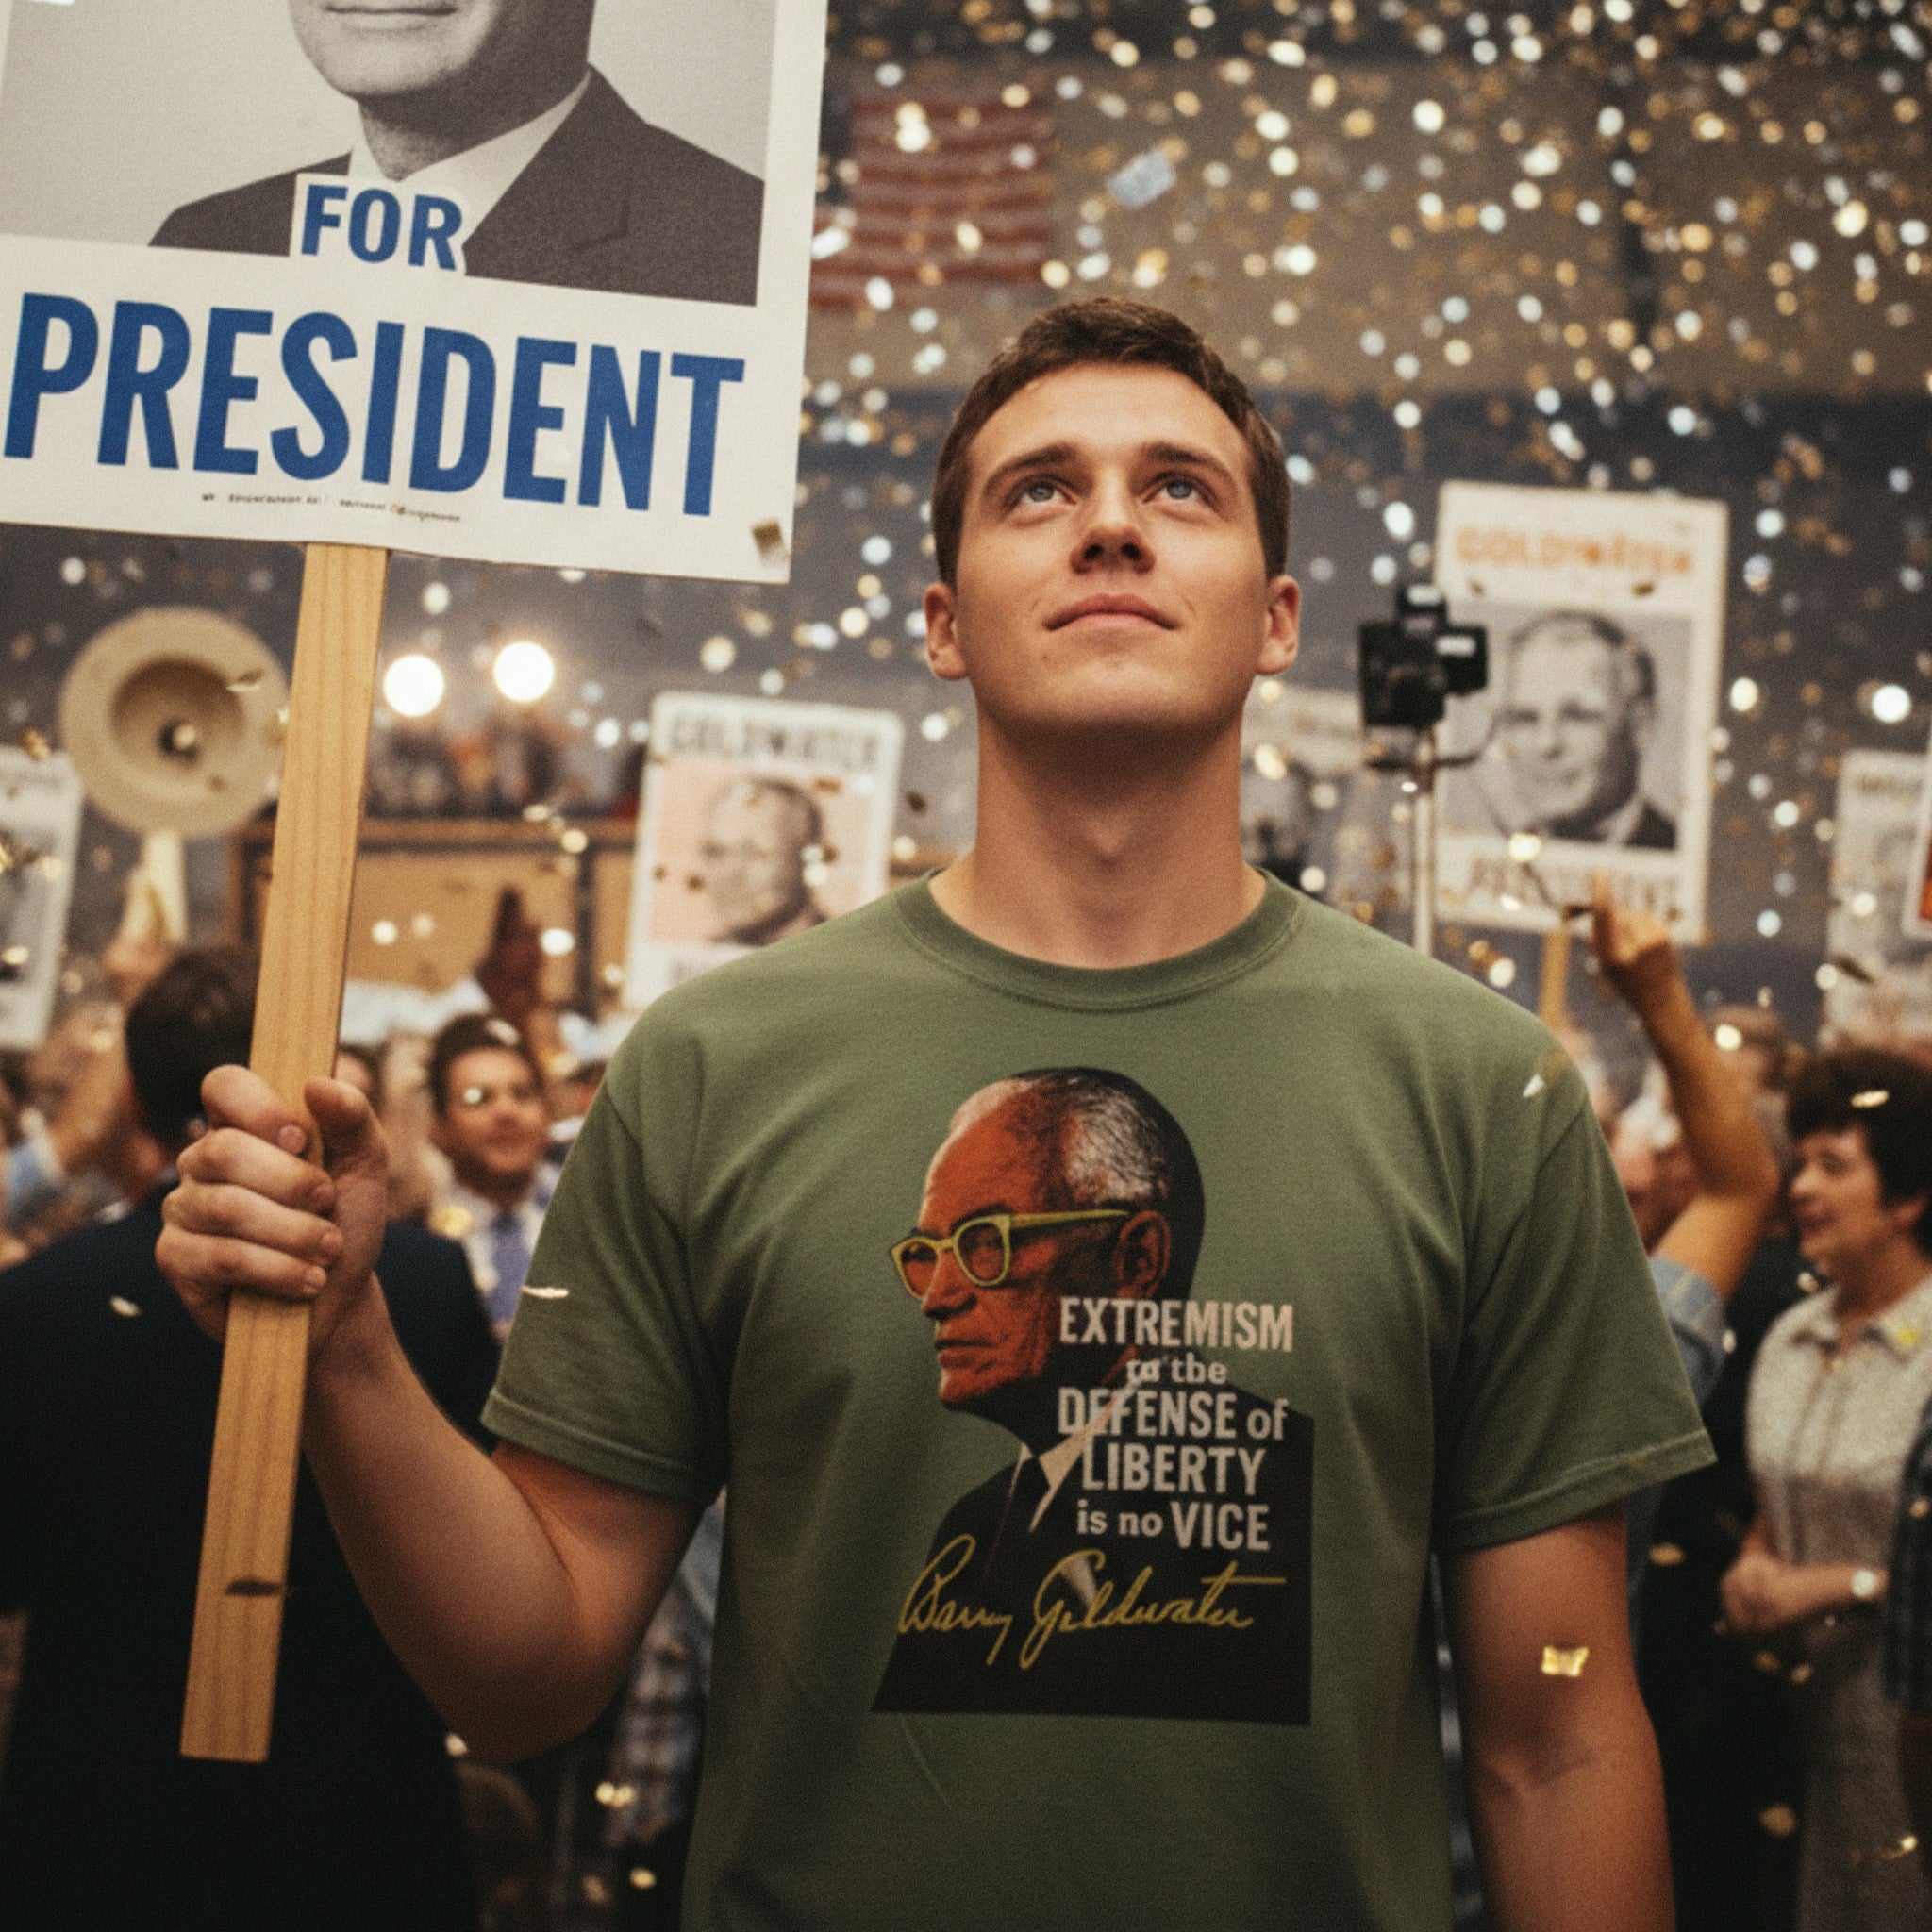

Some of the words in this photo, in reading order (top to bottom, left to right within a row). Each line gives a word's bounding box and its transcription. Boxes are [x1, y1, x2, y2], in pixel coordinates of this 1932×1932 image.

[301, 184, 463, 272] FOR
[4, 292, 745, 517] PRESIDENT
[1059, 1296, 1293, 1352] EXTREMISM
[1058, 1387, 1237, 1440] DEFENSE
[1246, 1398, 1289, 1441] of
[1082, 1440, 1266, 1495] LIBERTY
[1077, 1499, 1108, 1535] is
[1118, 1512, 1163, 1537] no
[1170, 1501, 1270, 1552] VICE
[898, 1533, 1013, 1667] Barry
